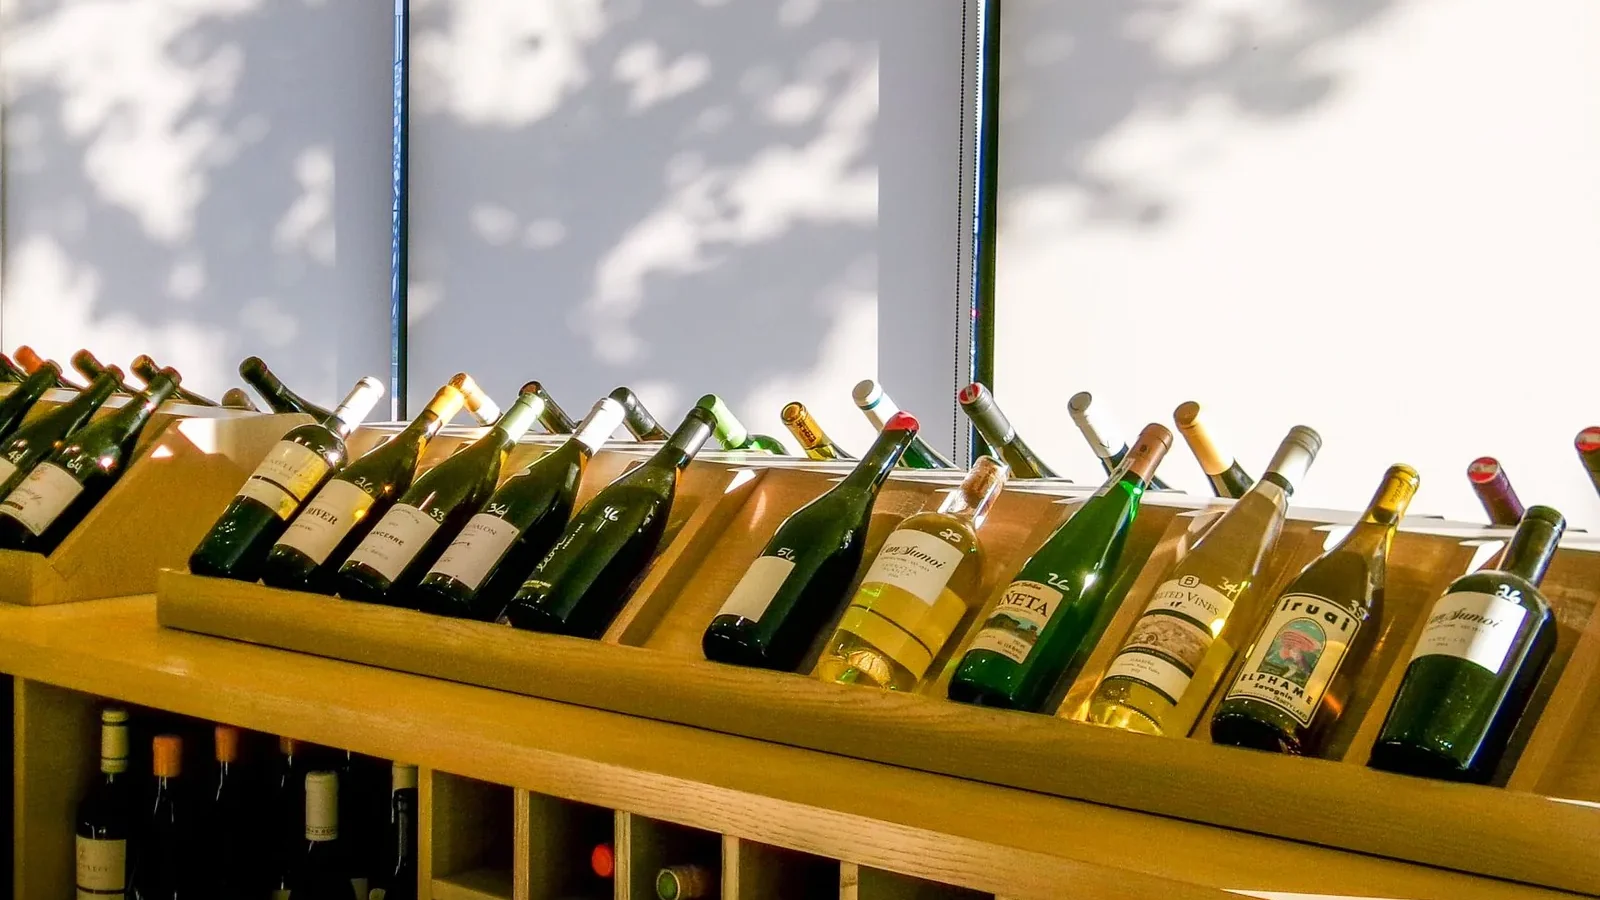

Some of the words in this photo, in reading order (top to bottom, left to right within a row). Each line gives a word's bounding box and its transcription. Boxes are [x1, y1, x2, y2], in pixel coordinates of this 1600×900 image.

[354, 476, 373, 494] 26
[305, 507, 338, 526] RIVER
[429, 507, 445, 522] 33
[603, 505, 619, 522] 46
[370, 530, 405, 546] ANCERRE
[898, 544, 946, 569] Sumoi
[1047, 572, 1070, 592] 26
[998, 590, 1048, 618] ÑETA
[1186, 591, 1220, 616] VINES
[1281, 598, 1350, 632] iruai
[1240, 673, 1314, 705] ELPHAME
[1253, 682, 1294, 702] Savagnin
